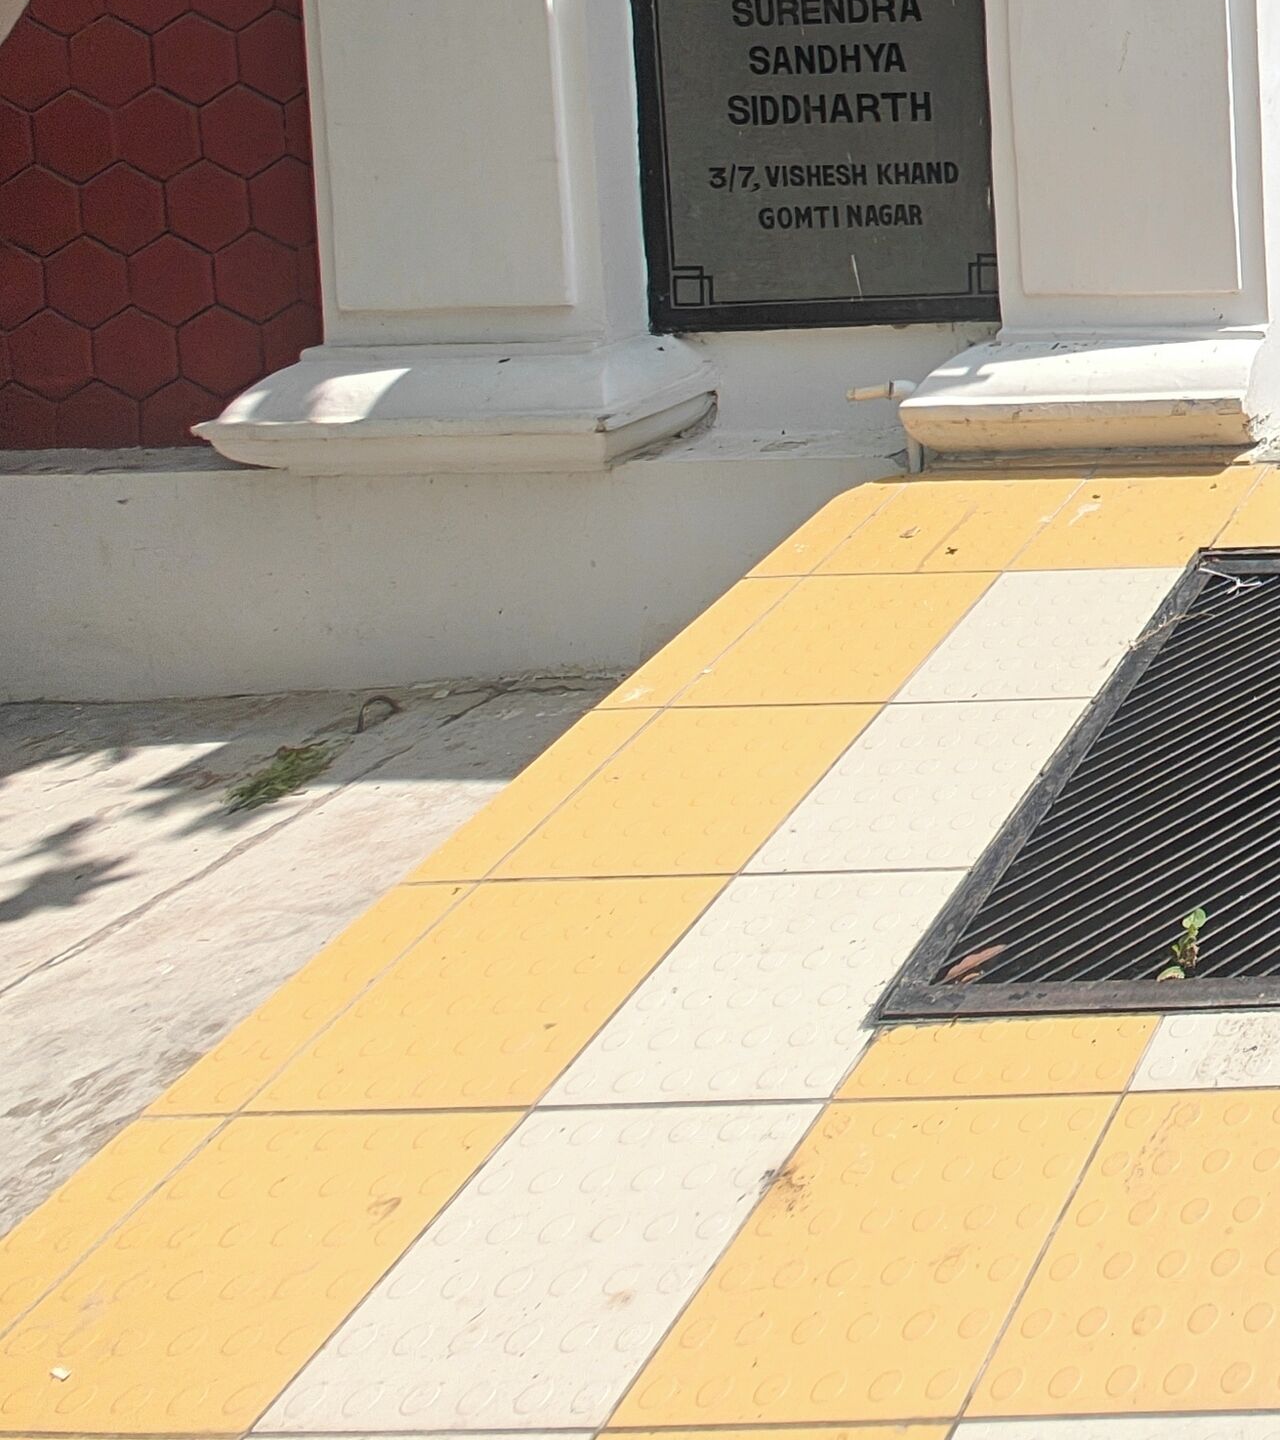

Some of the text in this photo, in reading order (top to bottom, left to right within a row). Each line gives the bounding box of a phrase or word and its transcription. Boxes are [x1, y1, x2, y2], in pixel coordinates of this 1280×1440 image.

[749, 42, 906, 75] SANDHYA
[727, 91, 932, 126] SIDDHARTH
[708, 161, 960, 193] 3/7, VISHESH KHAND
[758, 204, 922, 230] GOMTI NAGAR
